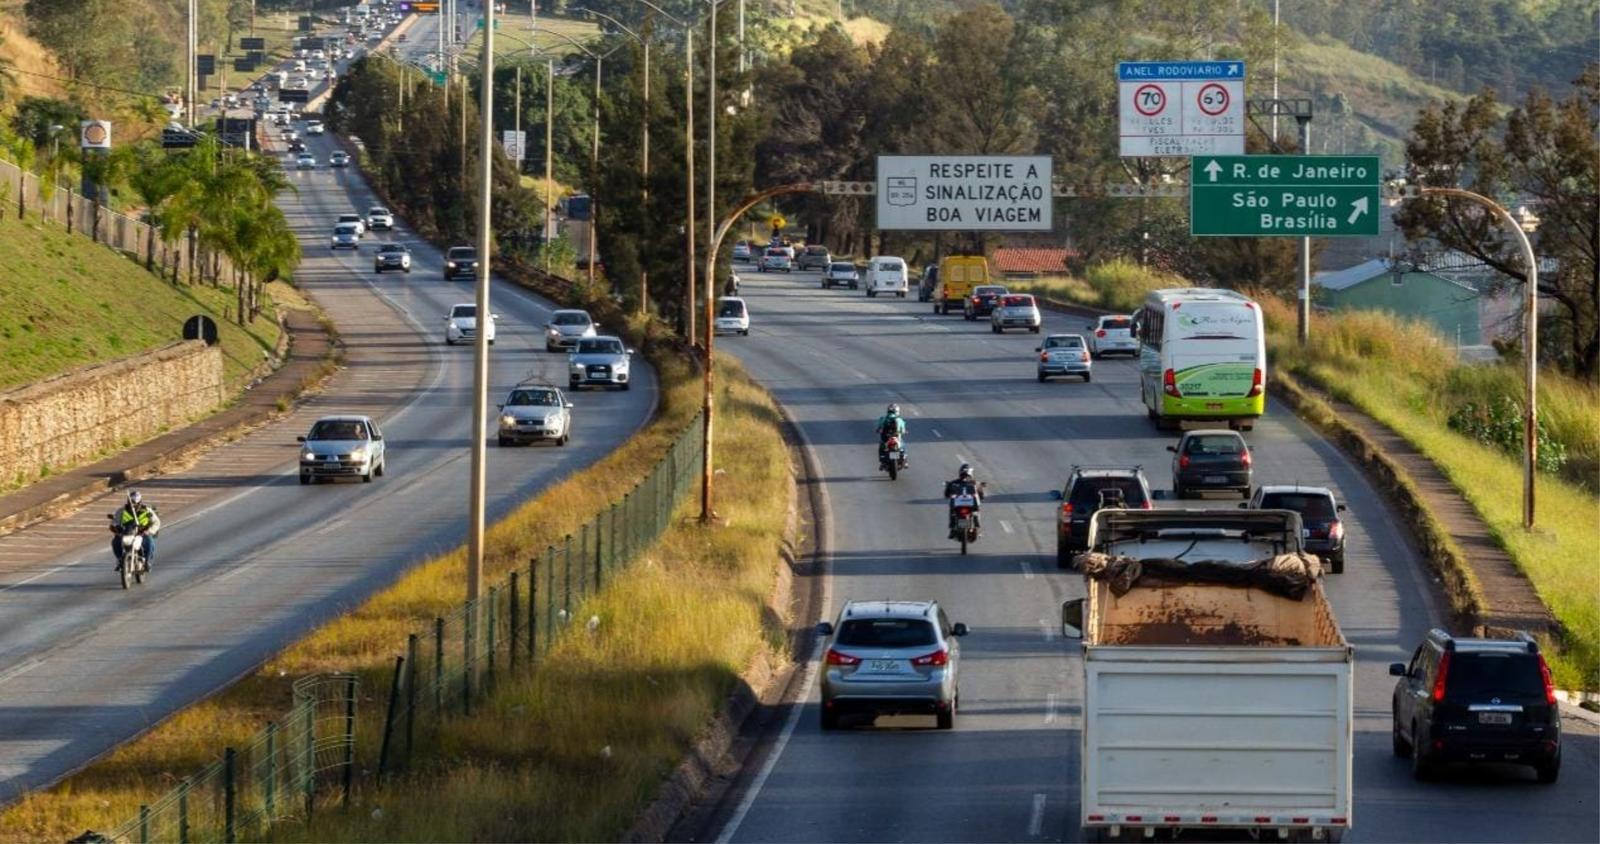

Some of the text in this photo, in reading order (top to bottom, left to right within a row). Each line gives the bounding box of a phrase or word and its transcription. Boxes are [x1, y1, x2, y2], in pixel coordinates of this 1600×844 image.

[1125, 65, 1222, 76] ANEL RODOVIARIO
[1140, 92, 1161, 106] 70
[930, 164, 1038, 179] RESPEITE A
[1232, 162, 1368, 179] R. de Janeiro
[926, 183, 1044, 204] SINALIZAÇÃO
[1232, 191, 1338, 208] São Paulo
[926, 207, 1042, 222] BOA VIAGEM
[1260, 210, 1338, 228] Brasília
